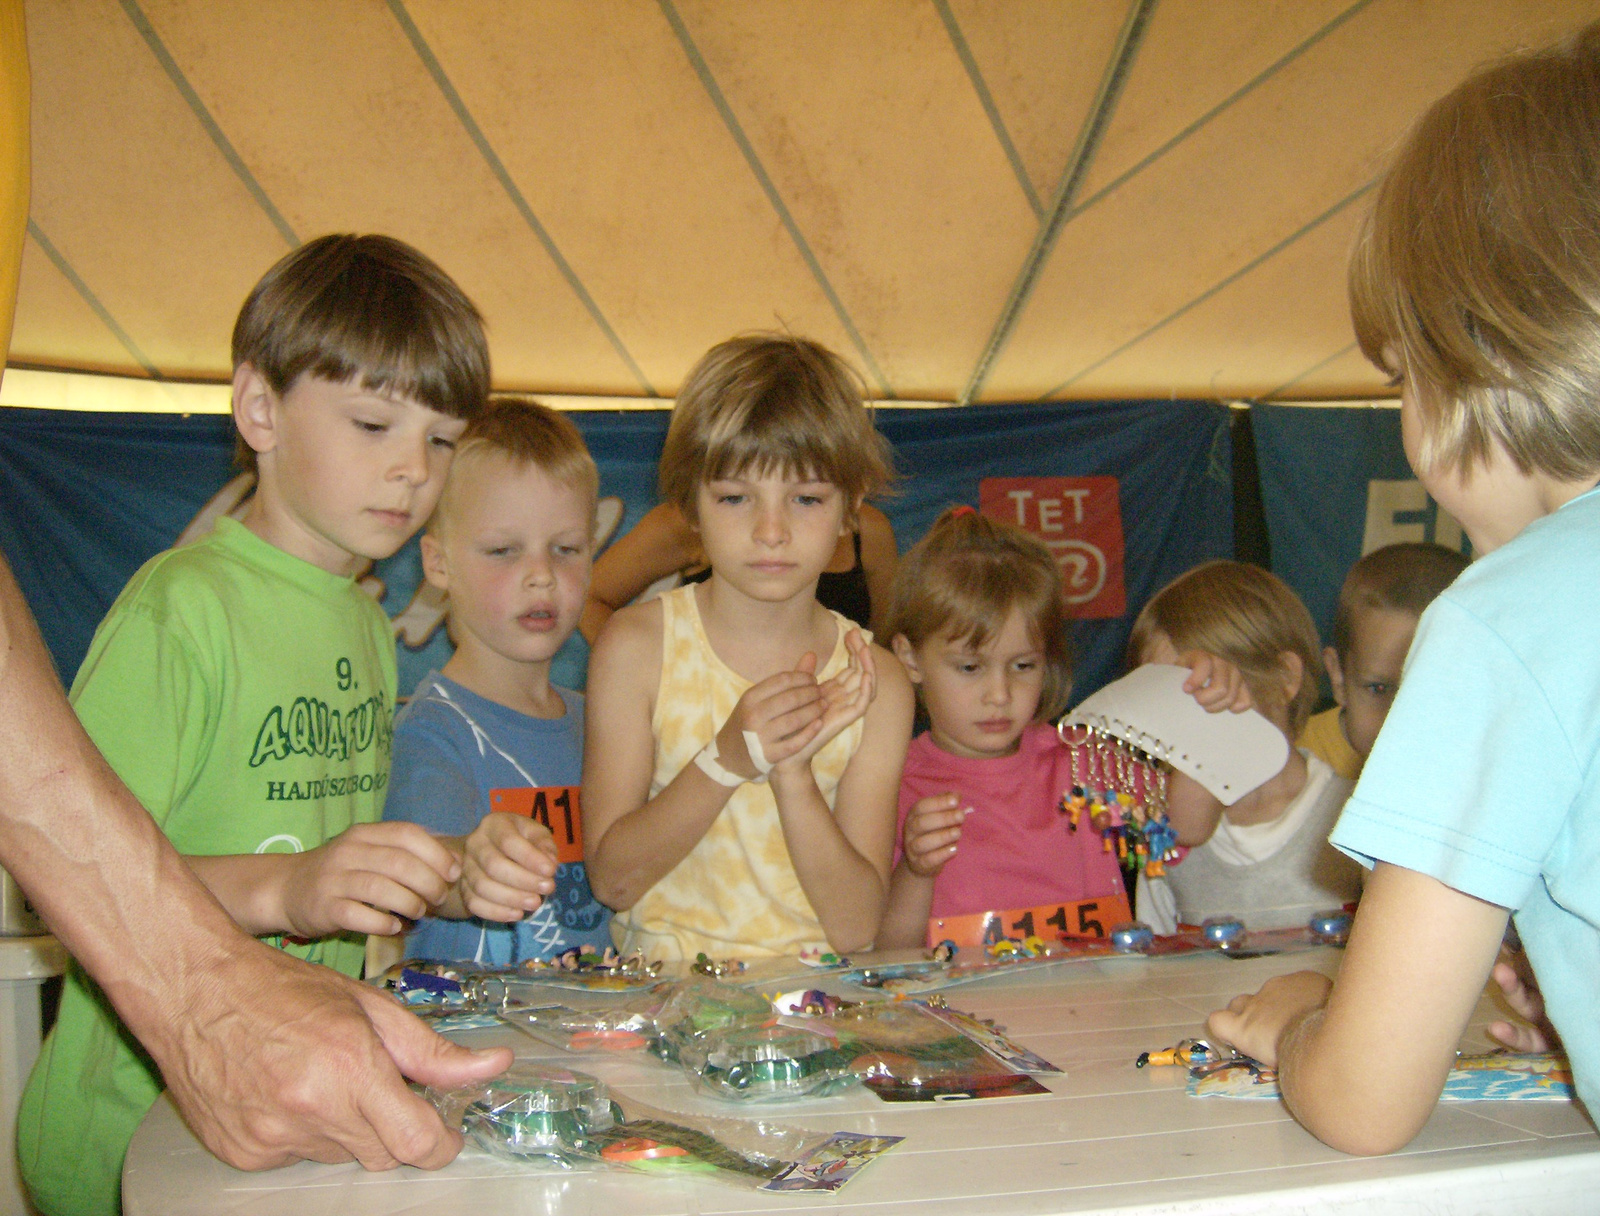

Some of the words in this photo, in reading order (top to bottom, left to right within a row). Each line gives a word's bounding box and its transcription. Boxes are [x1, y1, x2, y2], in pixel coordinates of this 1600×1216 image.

[1007, 489, 1090, 532] TET
[335, 657, 358, 691] 9.
[983, 903, 1104, 945] 4115
